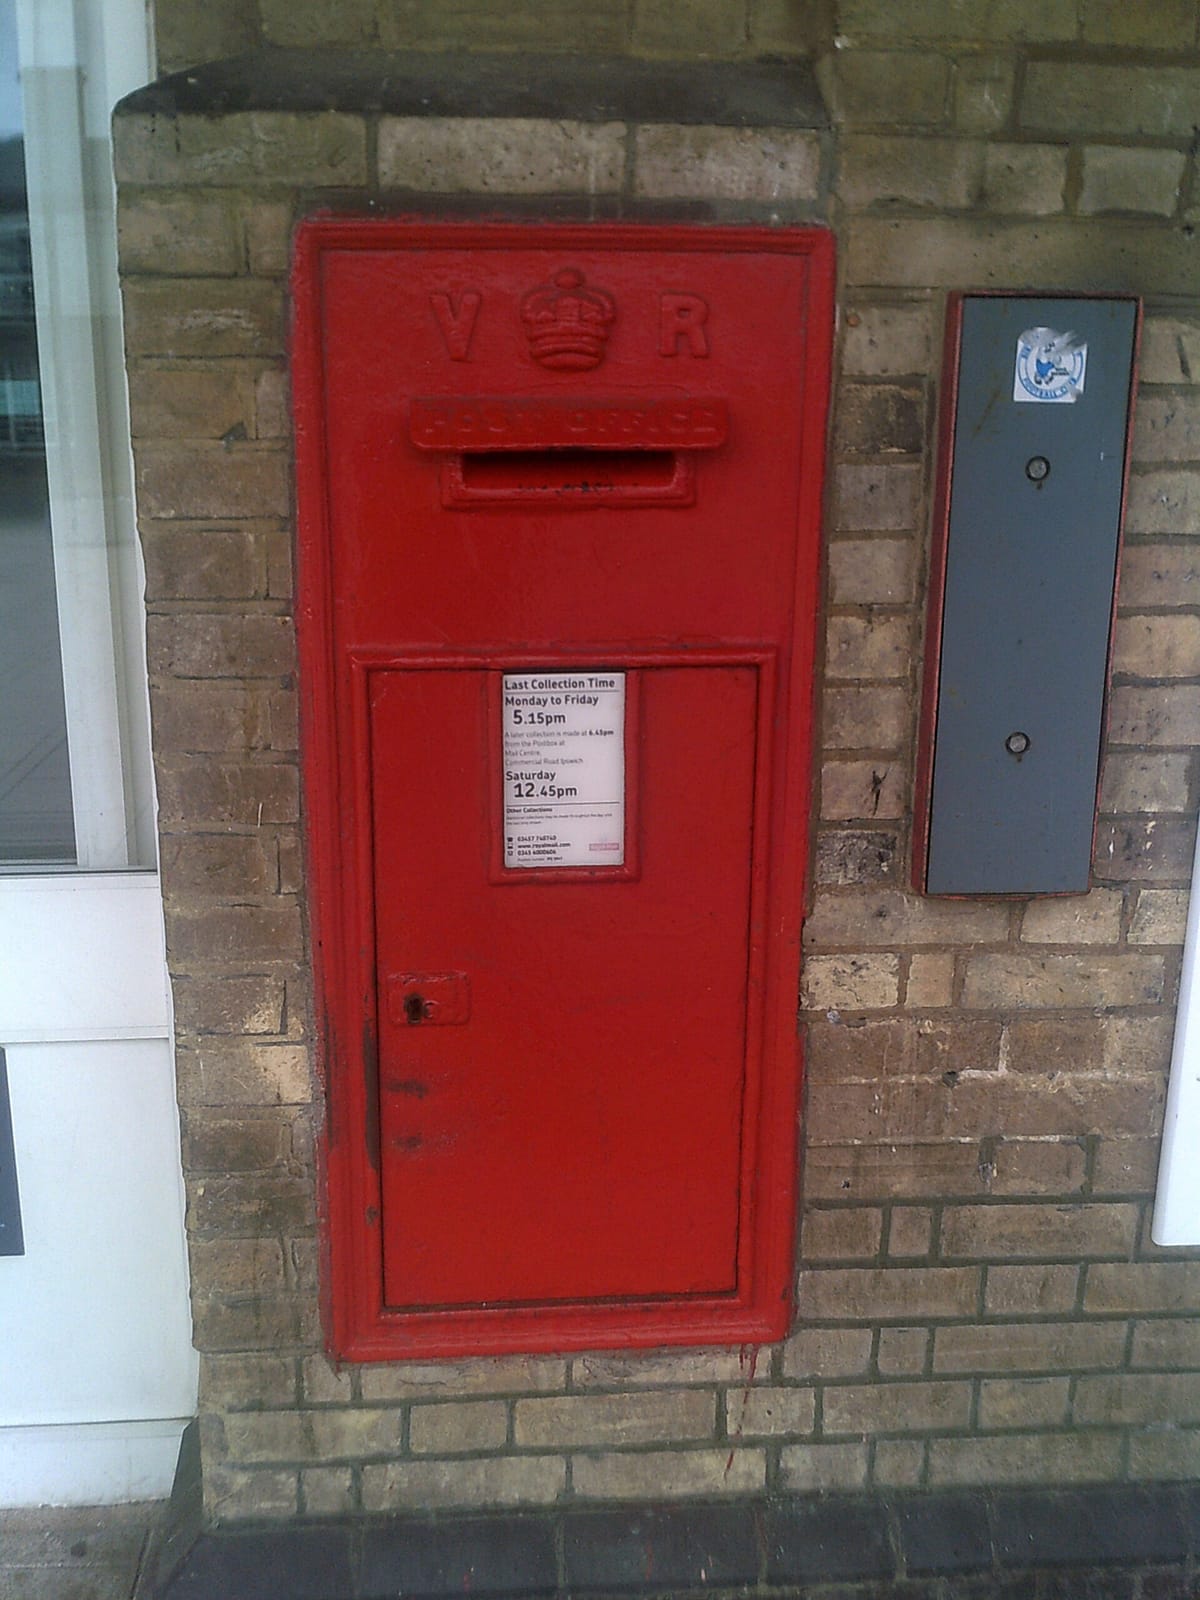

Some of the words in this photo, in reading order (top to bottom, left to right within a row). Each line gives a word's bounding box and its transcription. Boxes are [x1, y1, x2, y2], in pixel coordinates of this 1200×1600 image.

[429, 290, 481, 363] V
[658, 288, 710, 359] R
[505, 680, 529, 690] Last
[531, 678, 585, 690] Collection
[587, 678, 615, 688] Time
[505, 696, 548, 707] Monday
[550, 695, 562, 705] to
[564, 695, 599, 706] Friday
[513, 709, 566, 726] 5.15pm
[506, 770, 556, 781] Saturday
[514, 782, 578, 799] 12.45pm
